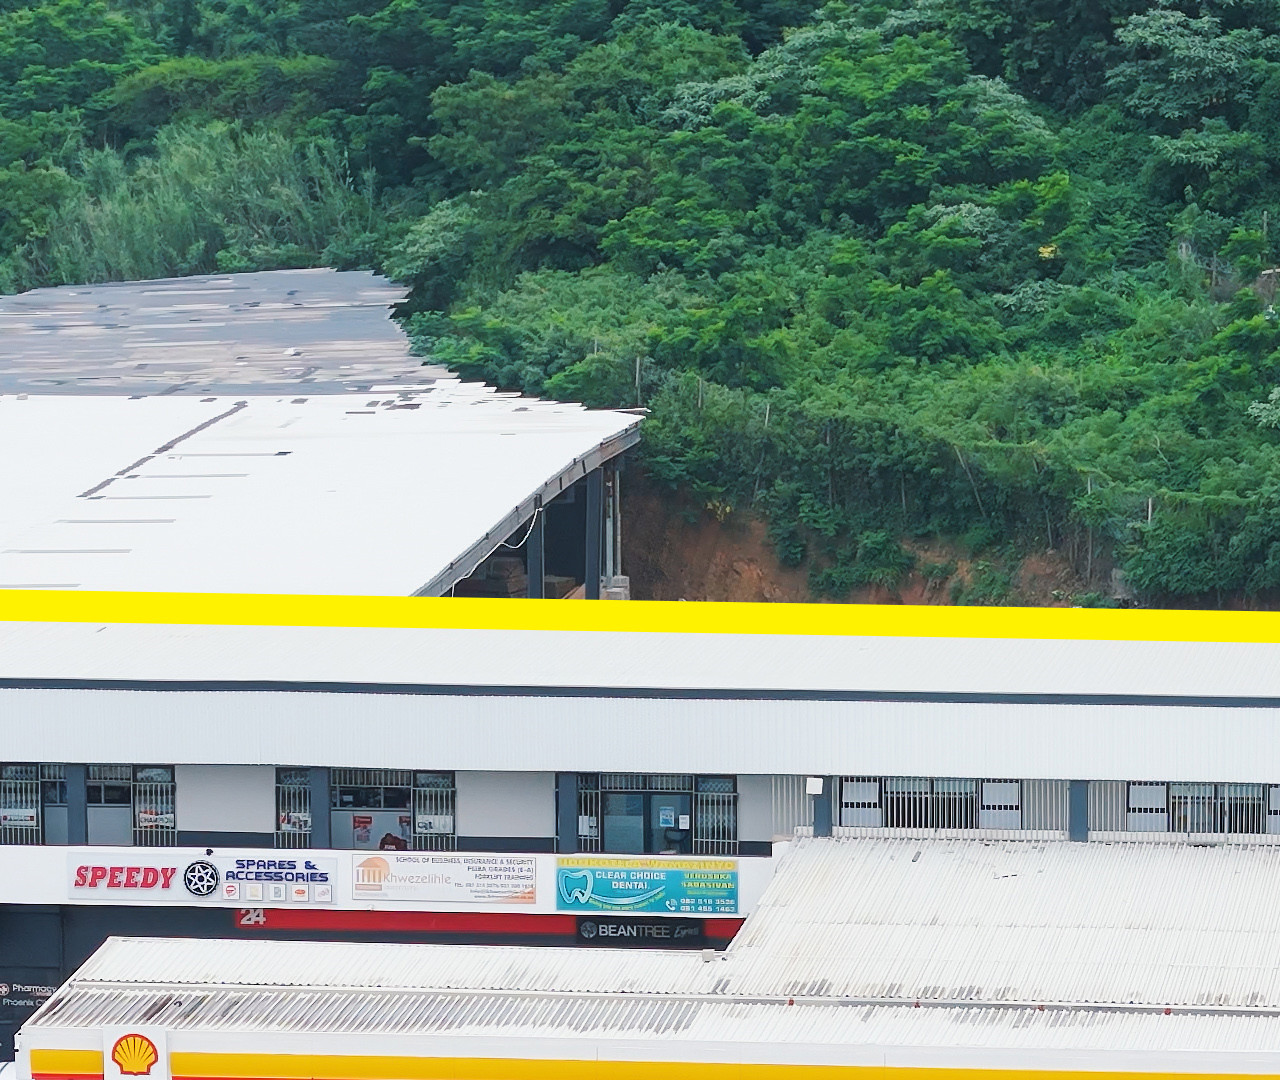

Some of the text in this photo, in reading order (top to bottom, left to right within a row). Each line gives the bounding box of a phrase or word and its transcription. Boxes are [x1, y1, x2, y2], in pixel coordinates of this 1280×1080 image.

[235, 859, 318, 870] SPARES &
[74, 866, 177, 889] SPEEDY
[225, 871, 329, 882] ACCESSORIES
[383, 871, 452, 885] Khwezelihle
[595, 872, 666, 880] CLEAR CHOICE
[612, 882, 650, 890] DENTAL
[240, 908, 266, 925] 24
[599, 925, 670, 938] BEANTREE
[12, 983, 57, 994] Pharmacy
